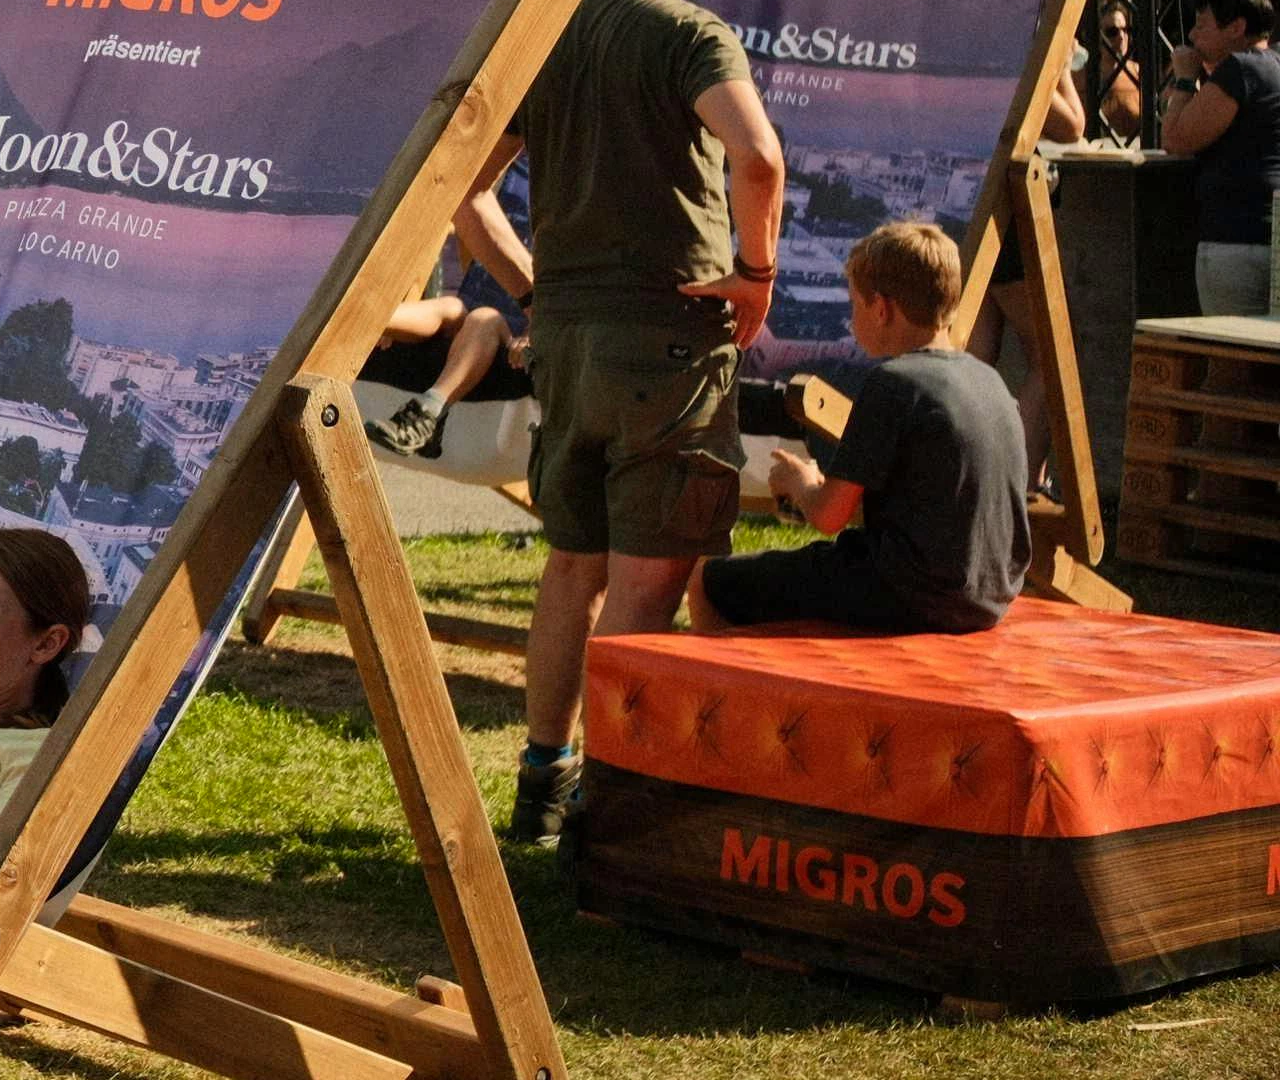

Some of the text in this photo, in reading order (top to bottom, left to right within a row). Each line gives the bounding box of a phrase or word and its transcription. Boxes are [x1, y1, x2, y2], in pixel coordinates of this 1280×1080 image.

[83, 34, 201, 68] präsentiert
[734, 22, 919, 70] on&Stars
[762, 89, 810, 108] ARNO
[771, 69, 845, 91] GRANDE
[4, 196, 168, 241] PIAZZA GRANDE
[19, 231, 120, 270] LOCARNO
[720, 827, 967, 928] MIGROS
